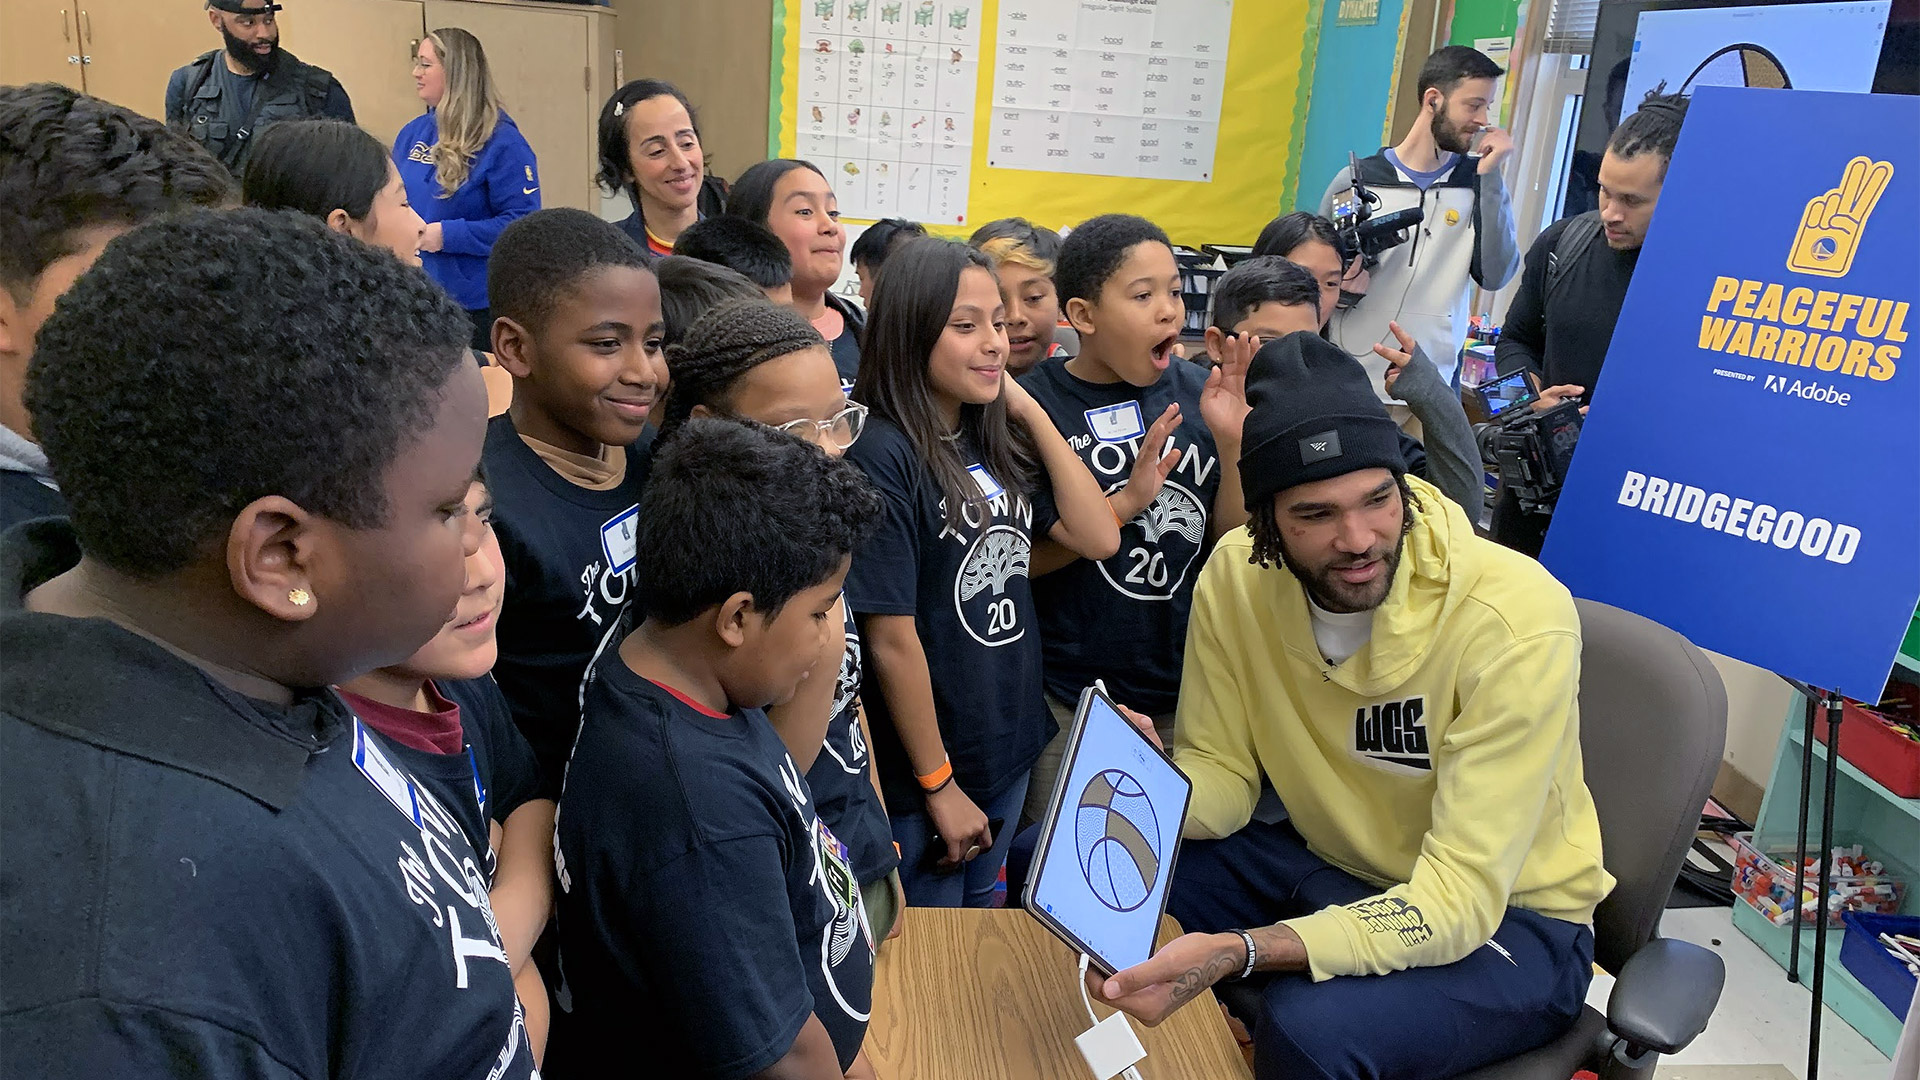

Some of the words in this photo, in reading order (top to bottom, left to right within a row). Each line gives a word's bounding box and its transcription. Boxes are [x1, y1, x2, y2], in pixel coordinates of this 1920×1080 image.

[1706, 275, 1911, 343] PEACEFUL
[1698, 315, 1902, 382] WARRIORS
[1713, 368, 1746, 381] PRESENTED
[1786, 379, 1851, 407] Adobe
[938, 494, 1033, 546] TOWN
[1616, 470, 1862, 566] BRIDGEGOOD
[576, 565, 640, 627] TO
[1125, 547, 1169, 588] 20
[987, 598, 1017, 636] 20
[1354, 696, 1432, 755] WCS
[398, 840, 444, 928] The
